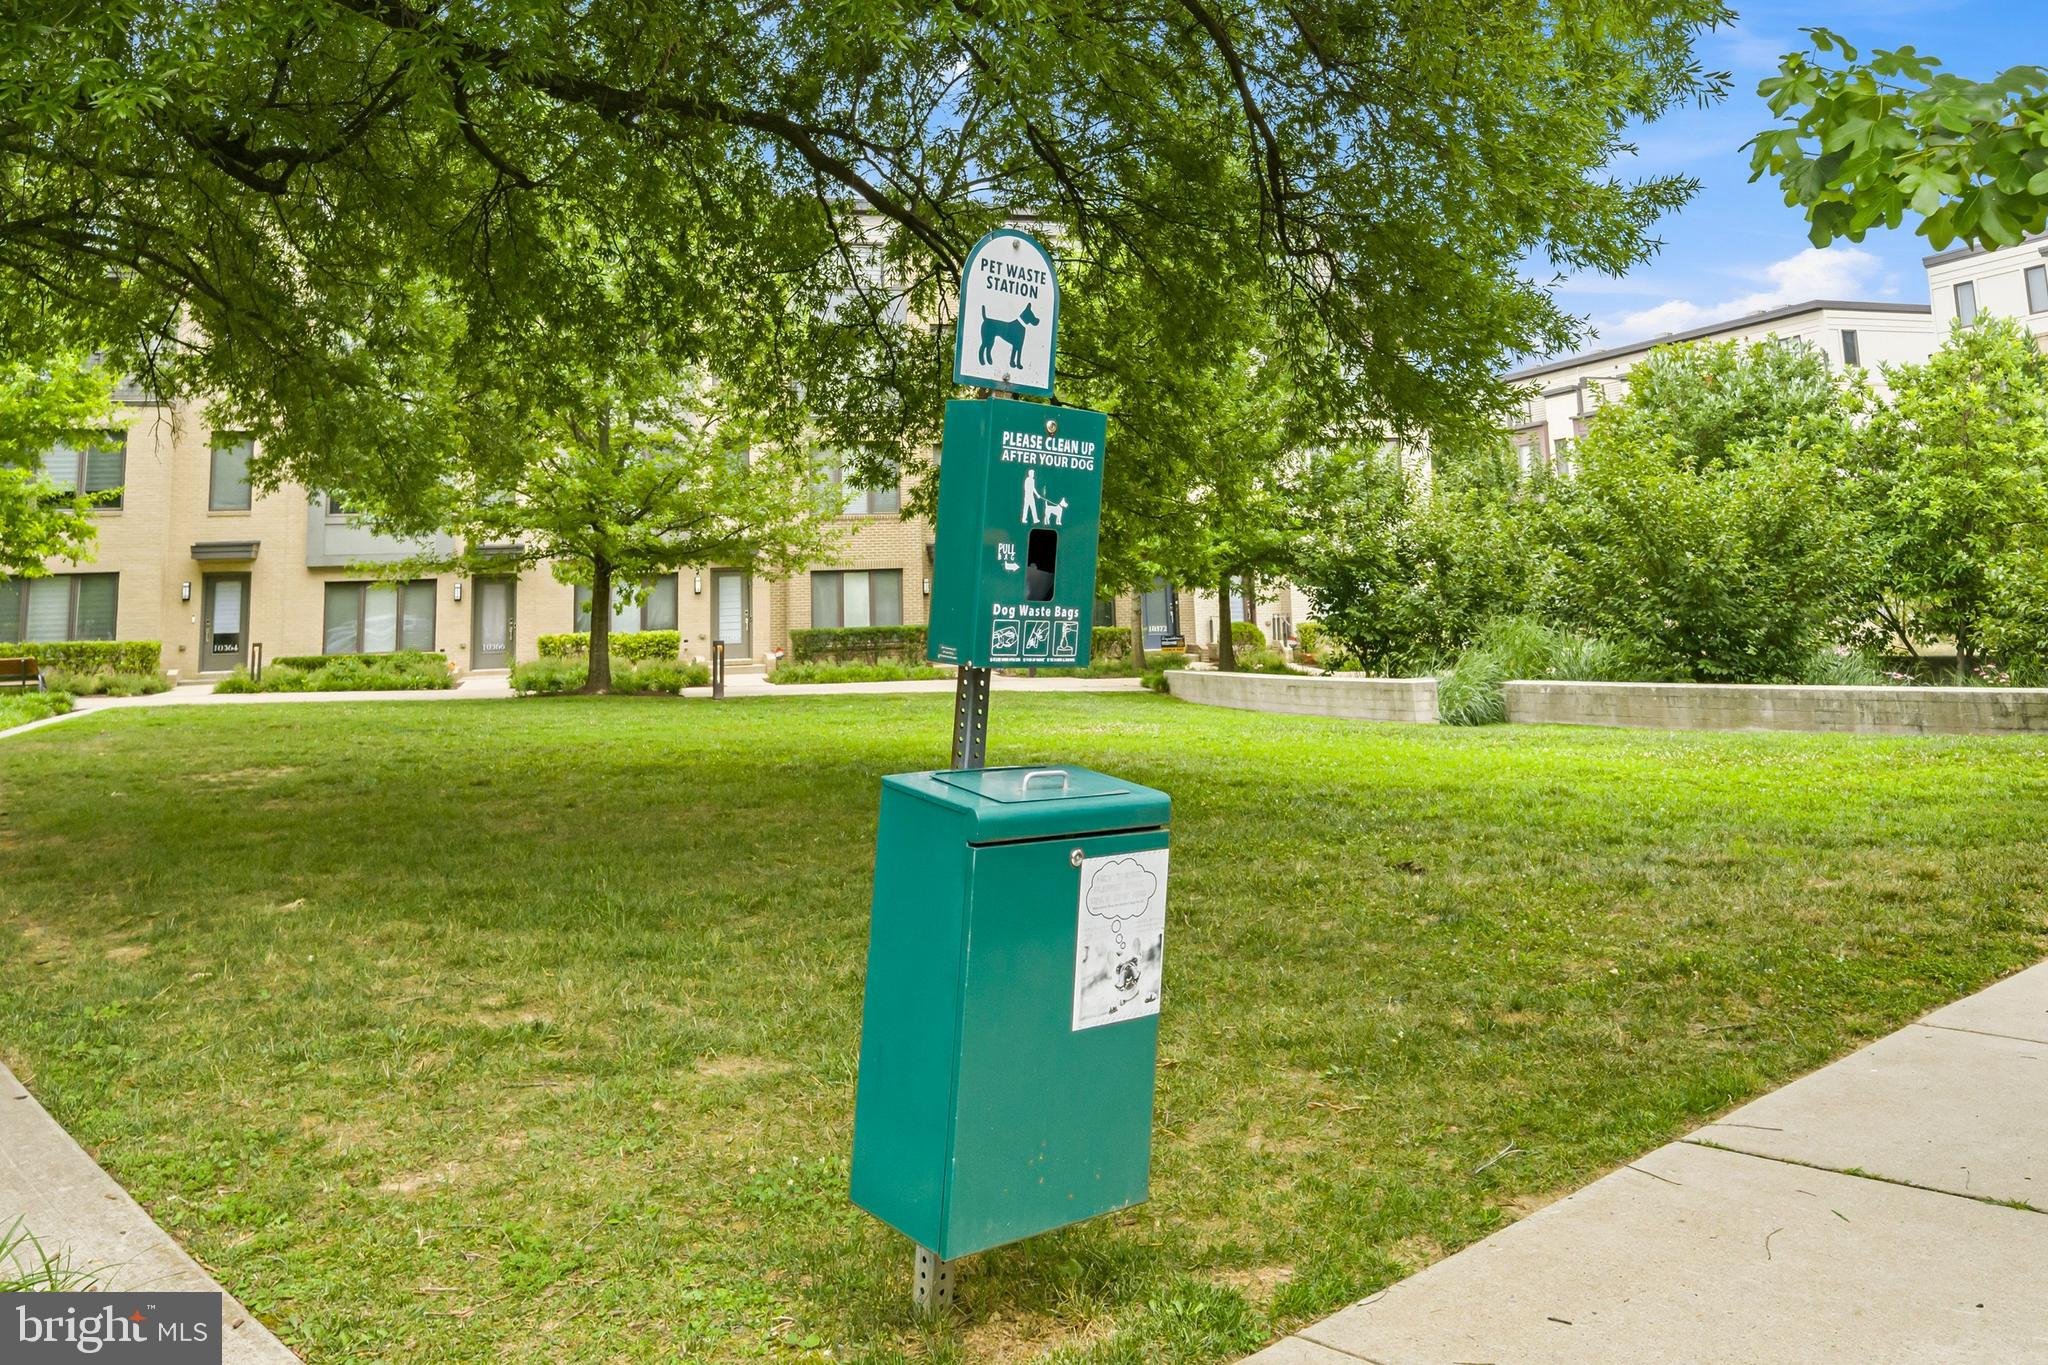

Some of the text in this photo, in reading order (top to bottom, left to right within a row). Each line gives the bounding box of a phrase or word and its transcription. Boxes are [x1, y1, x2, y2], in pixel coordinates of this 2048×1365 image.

[980, 257, 1047, 285] PET WASTE
[986, 275, 1039, 299] STATION
[1002, 431, 1095, 456] PLEASE CLEAN UP
[1001, 450, 1094, 471] AFTER YOUR DOG
[997, 543, 1016, 555] PULL
[993, 603, 1079, 620] Dog Waste Bags
